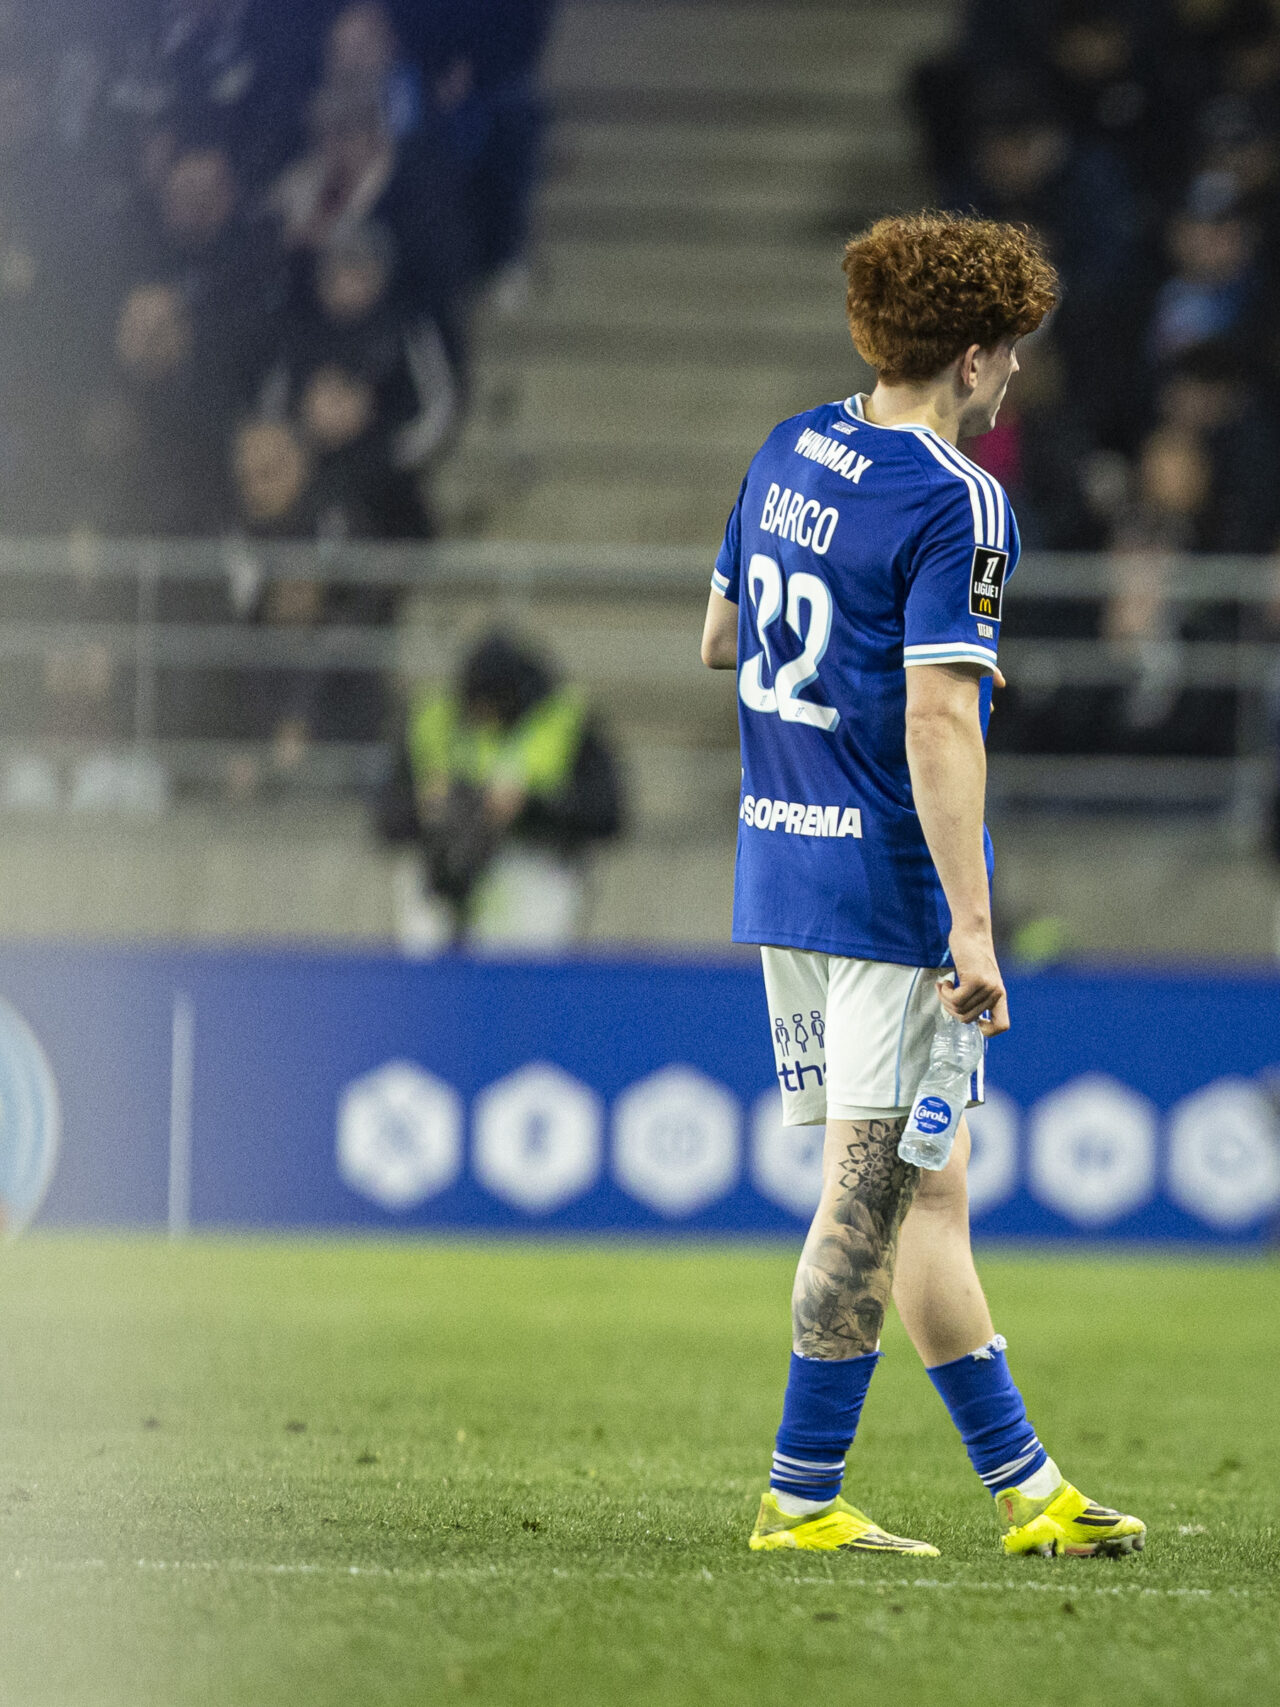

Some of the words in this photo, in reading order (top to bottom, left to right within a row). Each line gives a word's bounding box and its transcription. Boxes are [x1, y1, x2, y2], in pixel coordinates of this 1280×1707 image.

[794, 427, 874, 485] WINAMAX
[760, 482, 839, 555] BARCO
[739, 553, 841, 732] 32
[743, 794, 863, 839] SOPREMA
[915, 1105, 949, 1125] Carola
